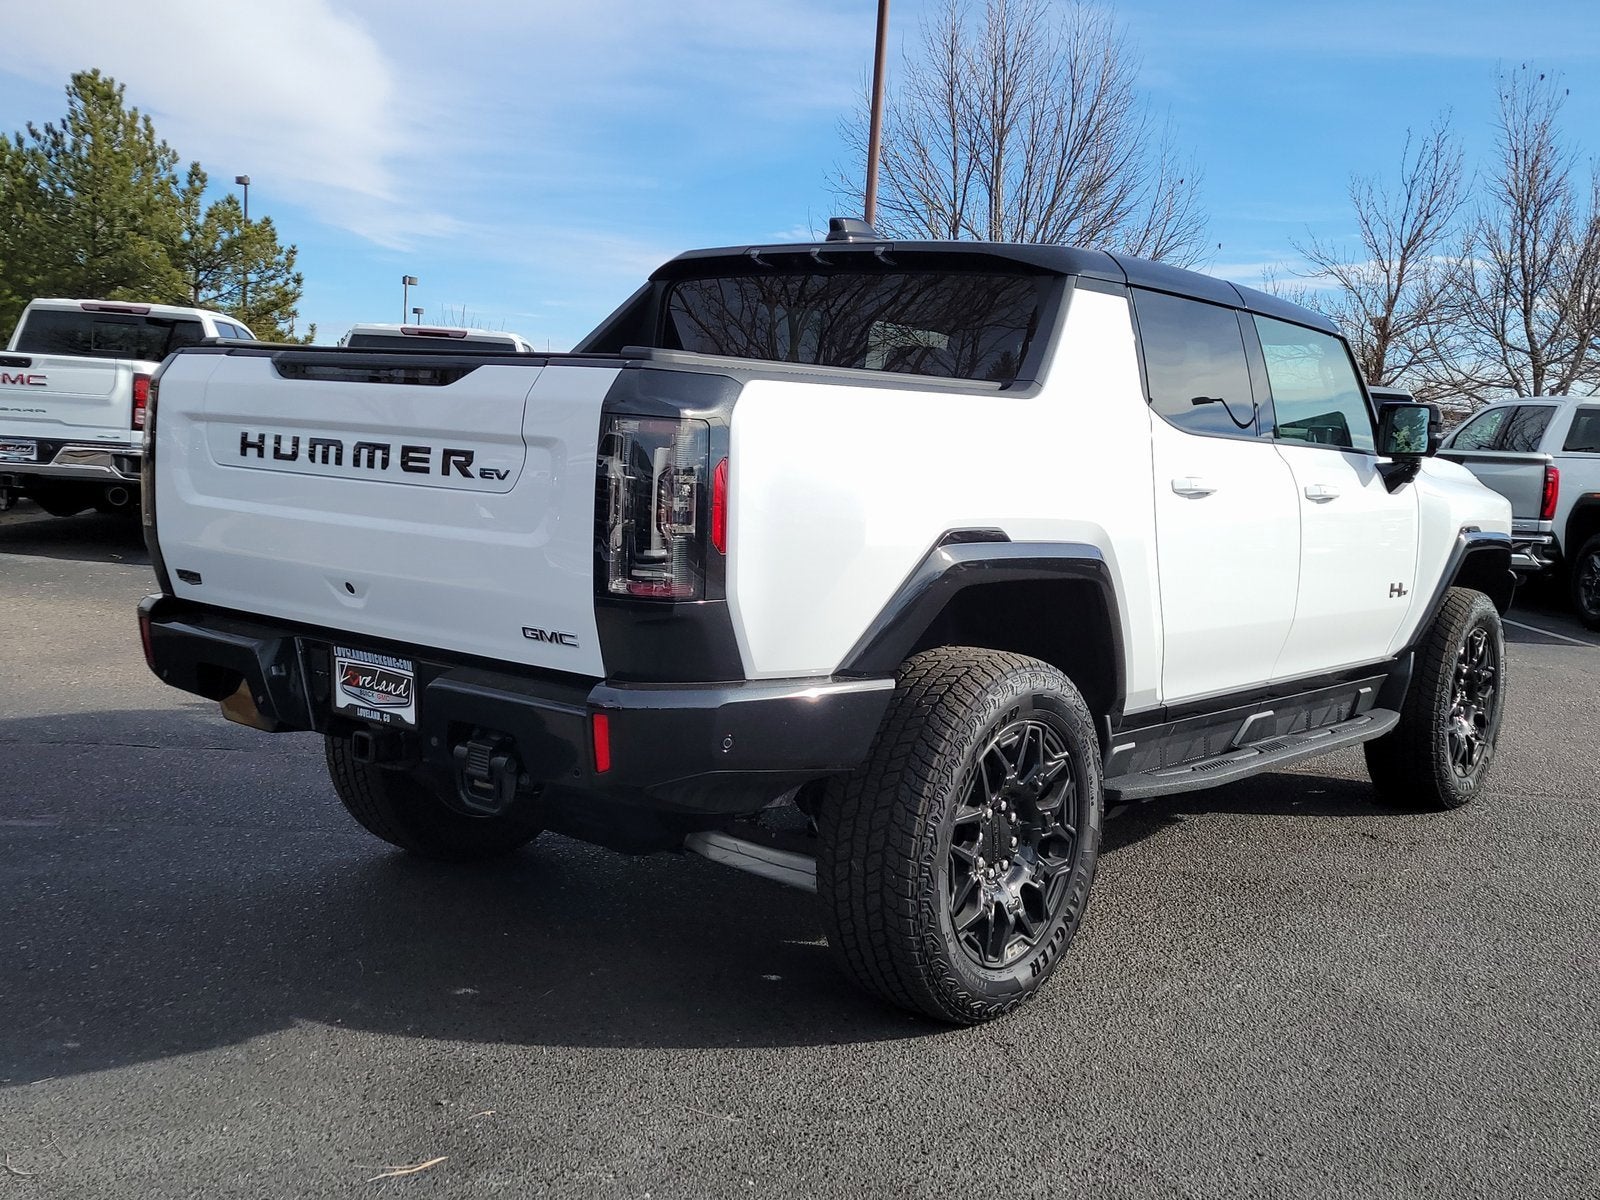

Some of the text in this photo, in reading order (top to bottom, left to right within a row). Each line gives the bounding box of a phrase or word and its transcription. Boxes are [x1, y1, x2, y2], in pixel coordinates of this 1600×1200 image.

[0, 373, 47, 386] MC
[240, 431, 510, 481] HUMMER EV
[521, 626, 579, 648] GMC
